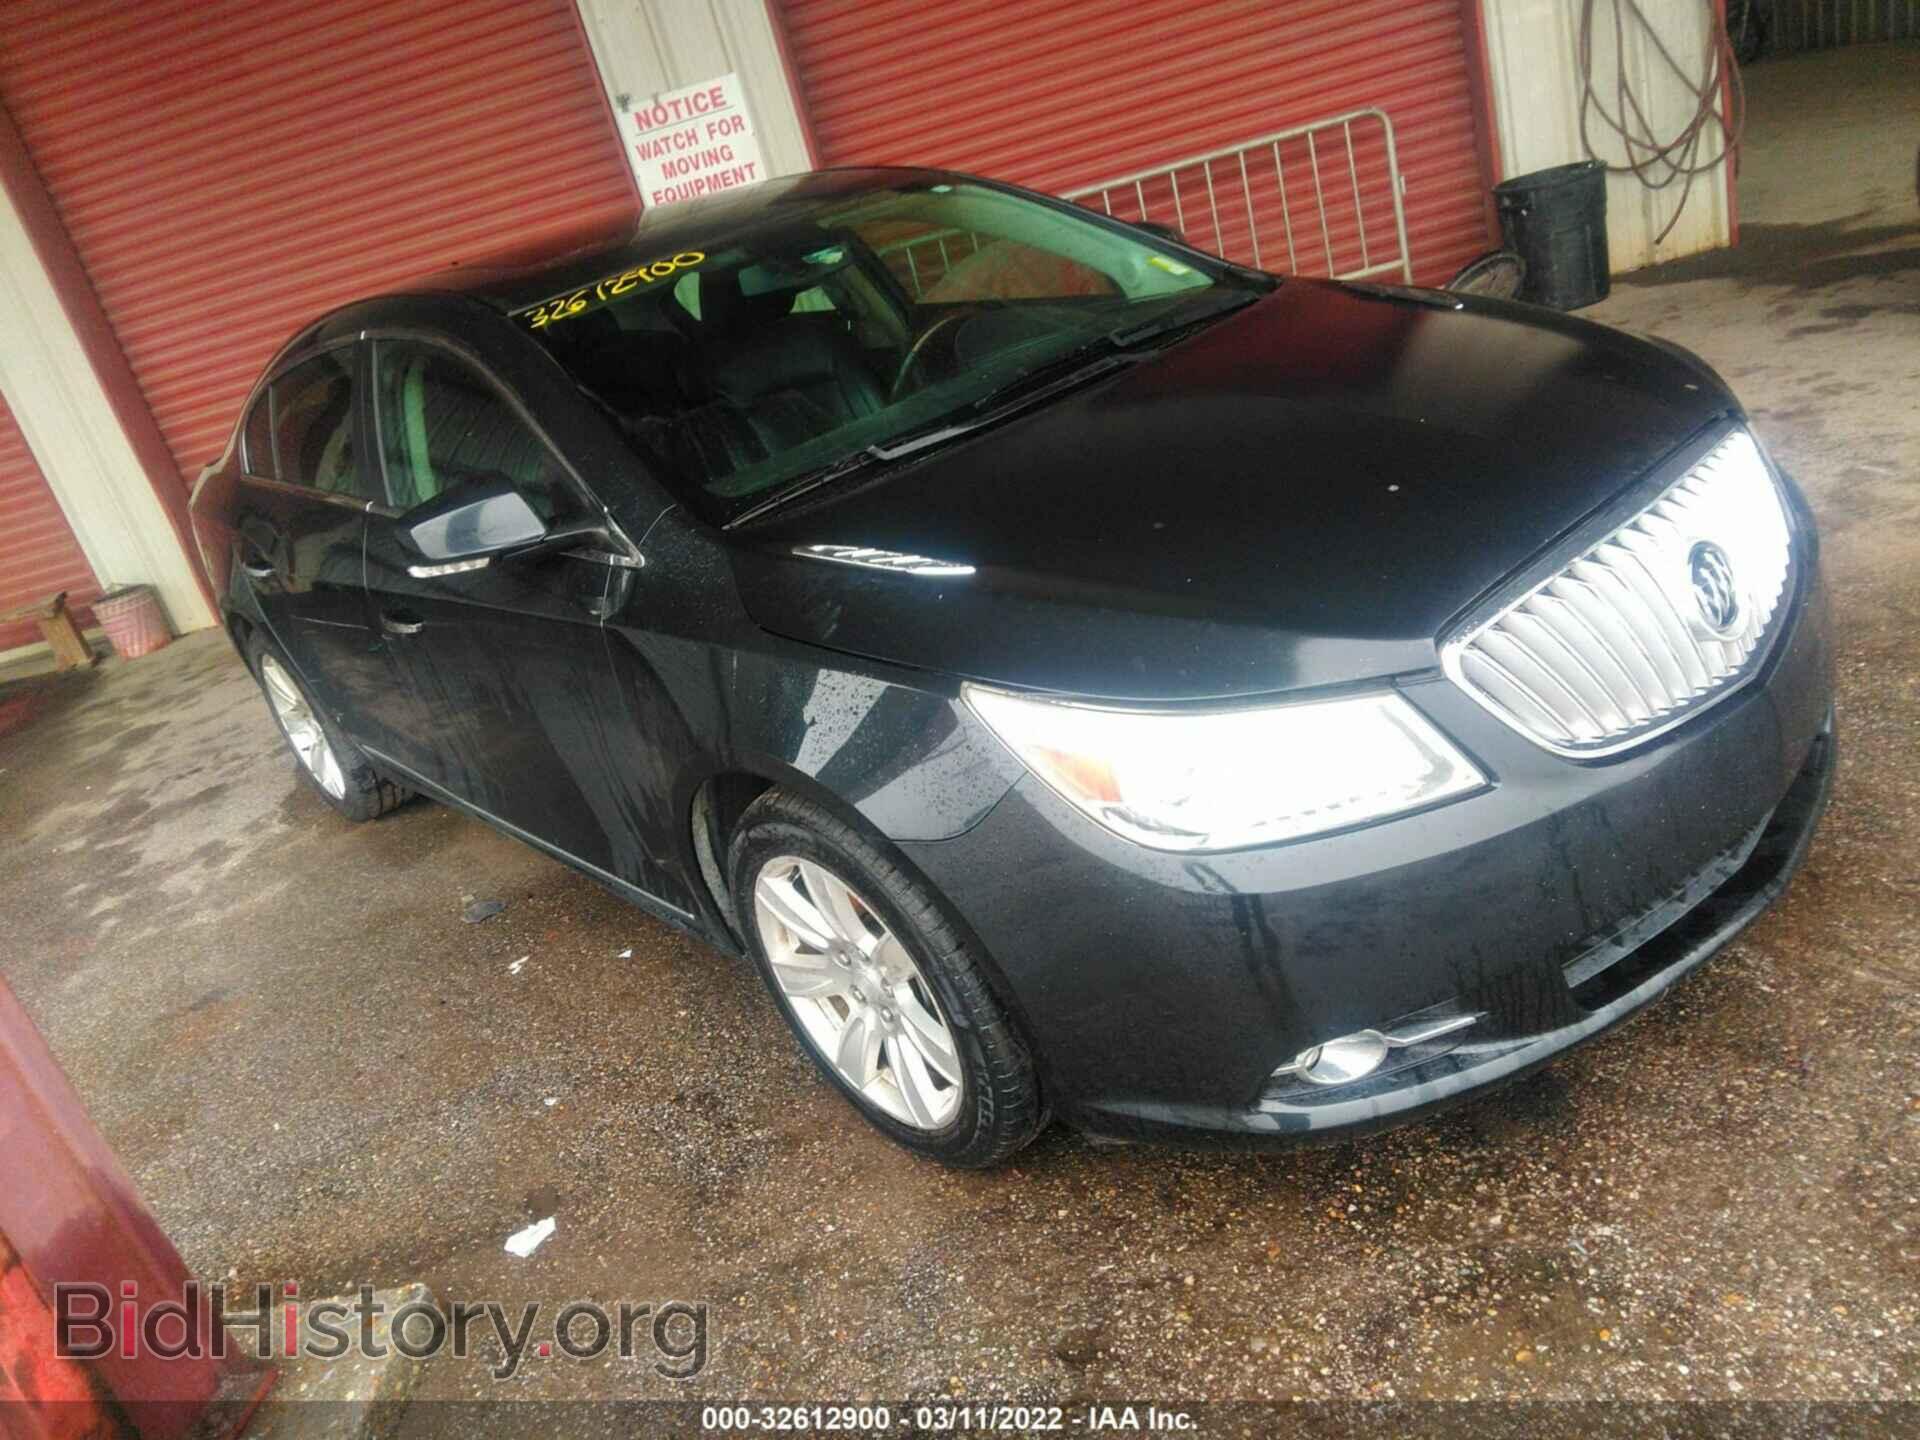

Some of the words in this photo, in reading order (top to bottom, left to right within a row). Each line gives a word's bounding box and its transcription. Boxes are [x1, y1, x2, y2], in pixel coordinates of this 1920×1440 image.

[634, 86, 727, 131] NOTICE
[635, 131, 699, 161] WATCH
[707, 115, 745, 141] FOR
[652, 162, 757, 206] EQUIPMENT
[661, 145, 735, 180] MOVING
